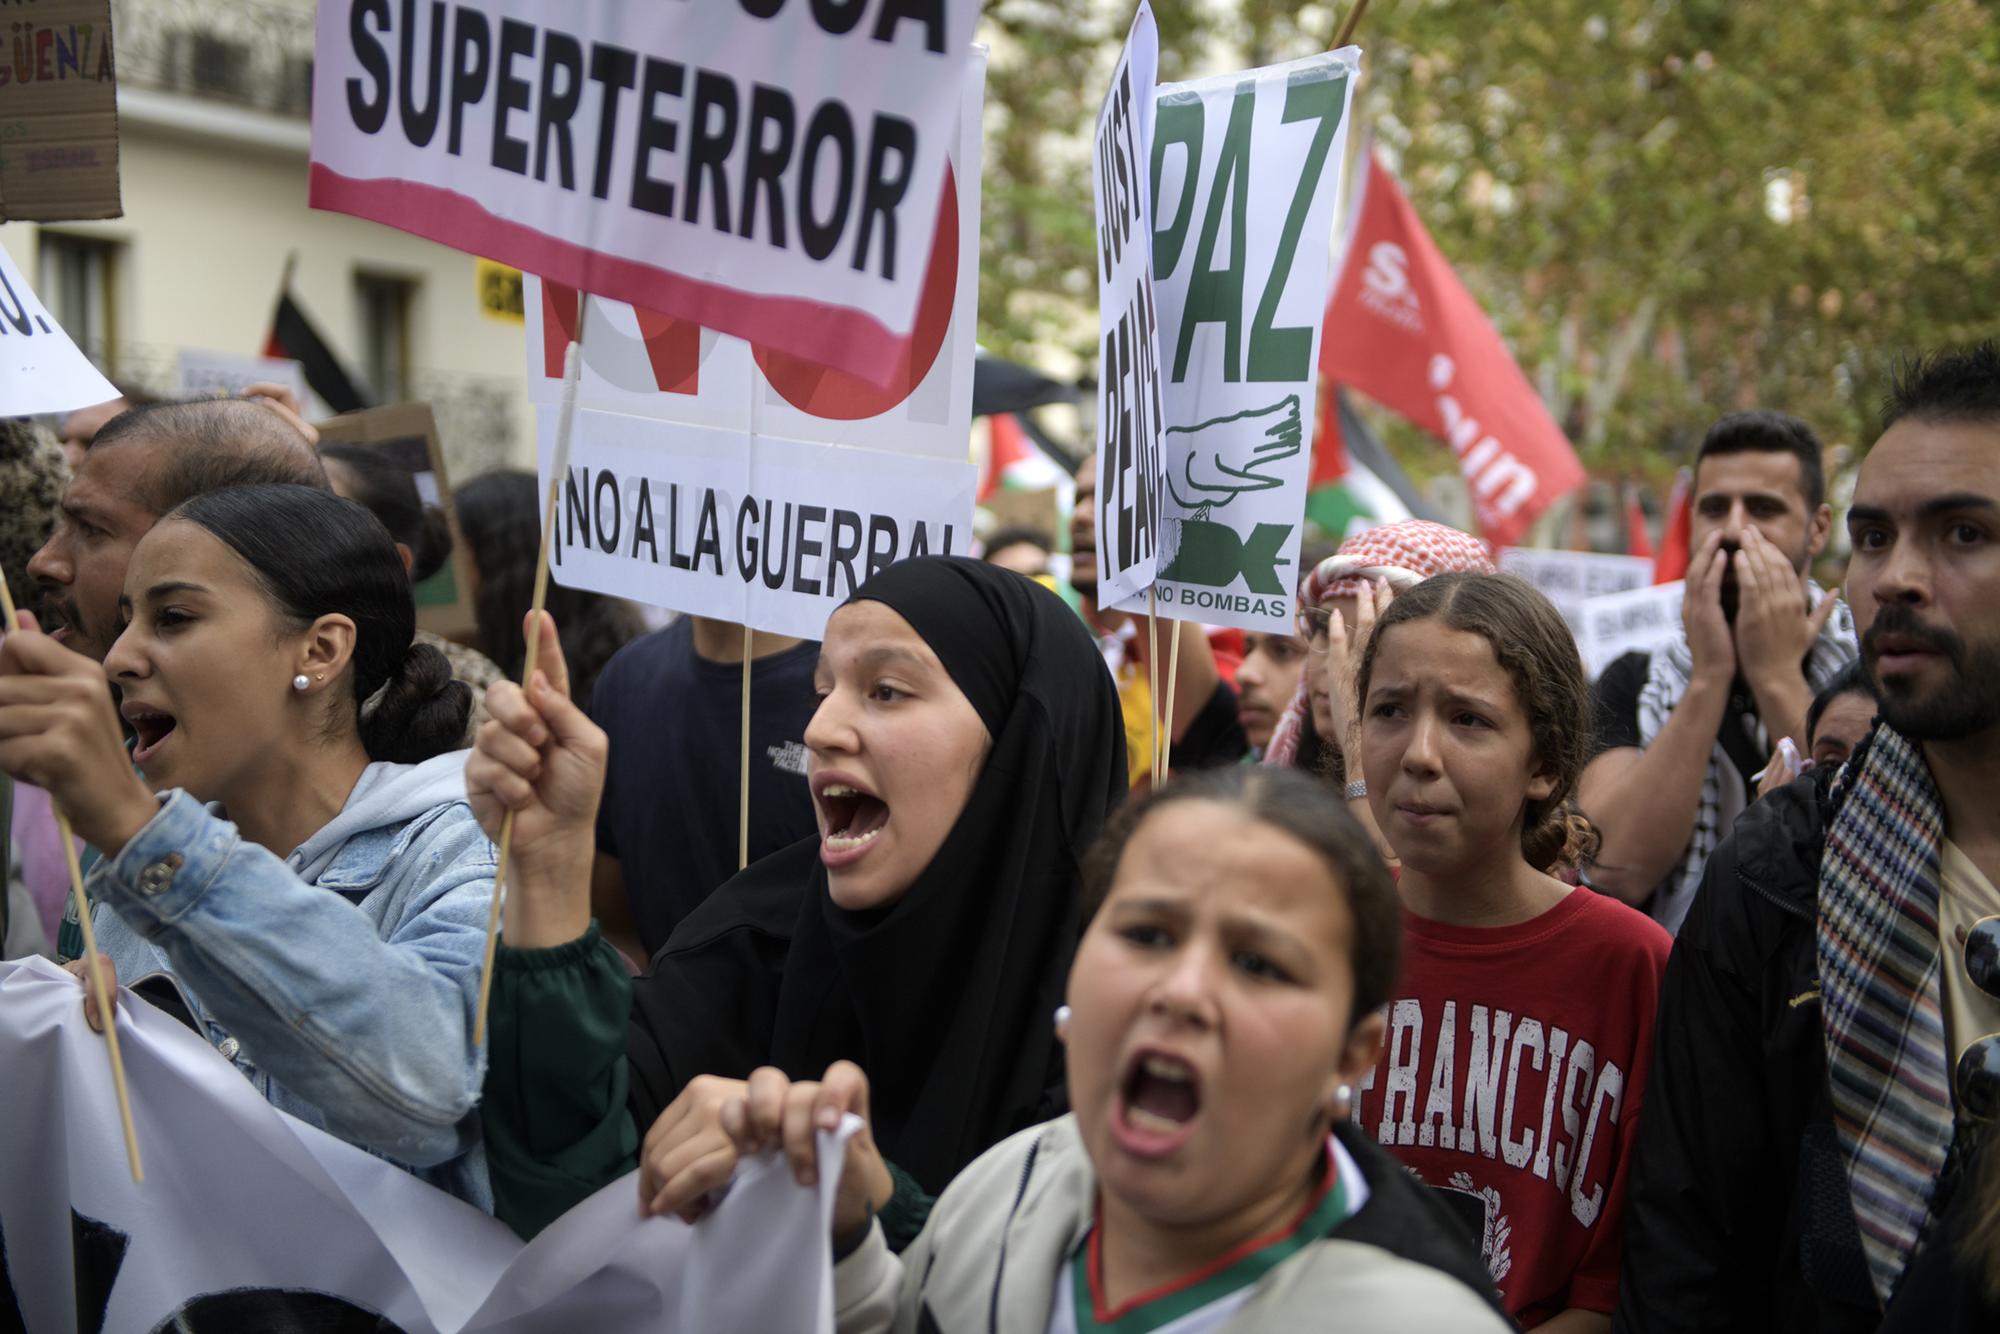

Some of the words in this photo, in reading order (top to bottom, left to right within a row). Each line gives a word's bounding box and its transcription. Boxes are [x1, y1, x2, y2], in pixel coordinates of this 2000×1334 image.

[346, 0, 917, 282] SUPERTERROR
[1100, 60, 1140, 284] JUST
[1150, 61, 1350, 383] PAZ
[632, 477, 658, 564] A
[670, 483, 724, 576] LA
[1102, 263, 1166, 580] PEACE
[1180, 589, 1287, 617] BOMBAS
